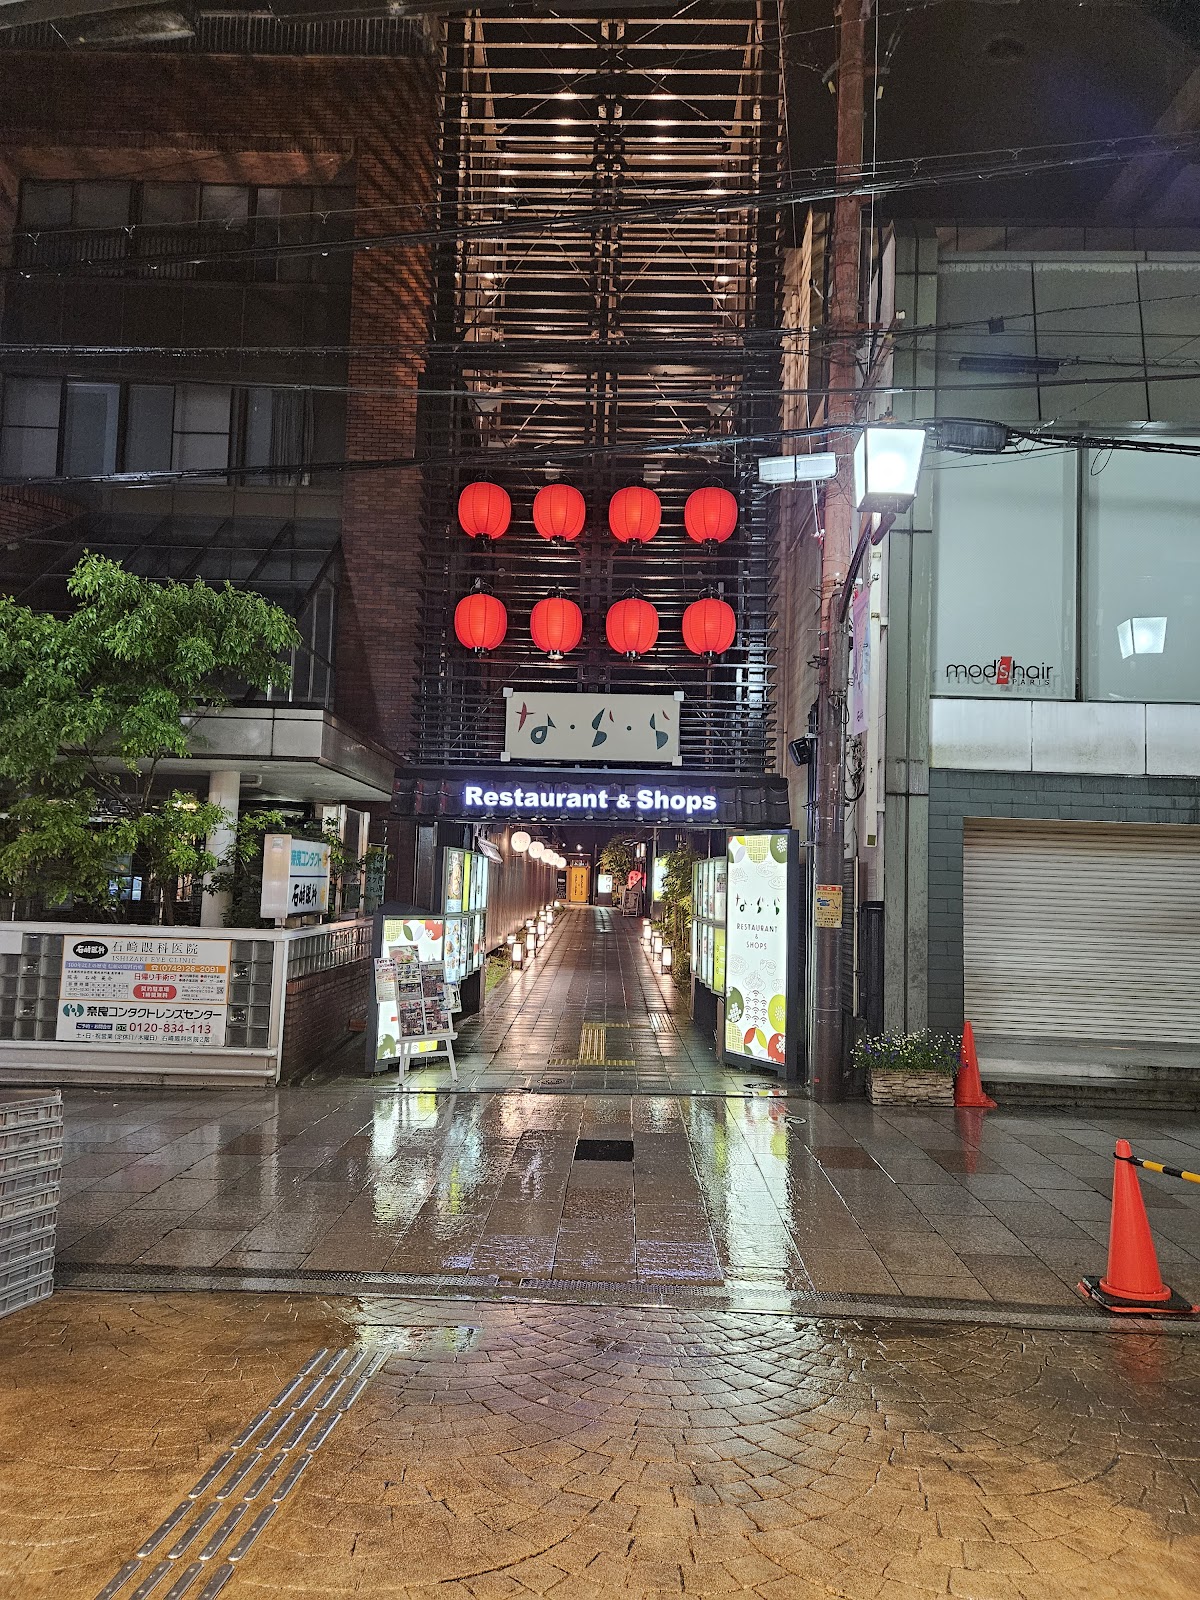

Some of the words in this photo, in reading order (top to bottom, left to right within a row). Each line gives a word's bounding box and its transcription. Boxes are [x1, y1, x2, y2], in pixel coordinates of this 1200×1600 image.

[465, 786, 608, 808] Restaurant
[617, 793, 631, 809] &
[637, 789, 717, 814] Shops
[736, 922, 778, 933] RESTAURANT
[746, 941, 767, 950] SHOPS
[86, 1006, 222, 1020] 奈良コンタクトレンズセンター
[129, 1022, 211, 1034] 0120-834-113
